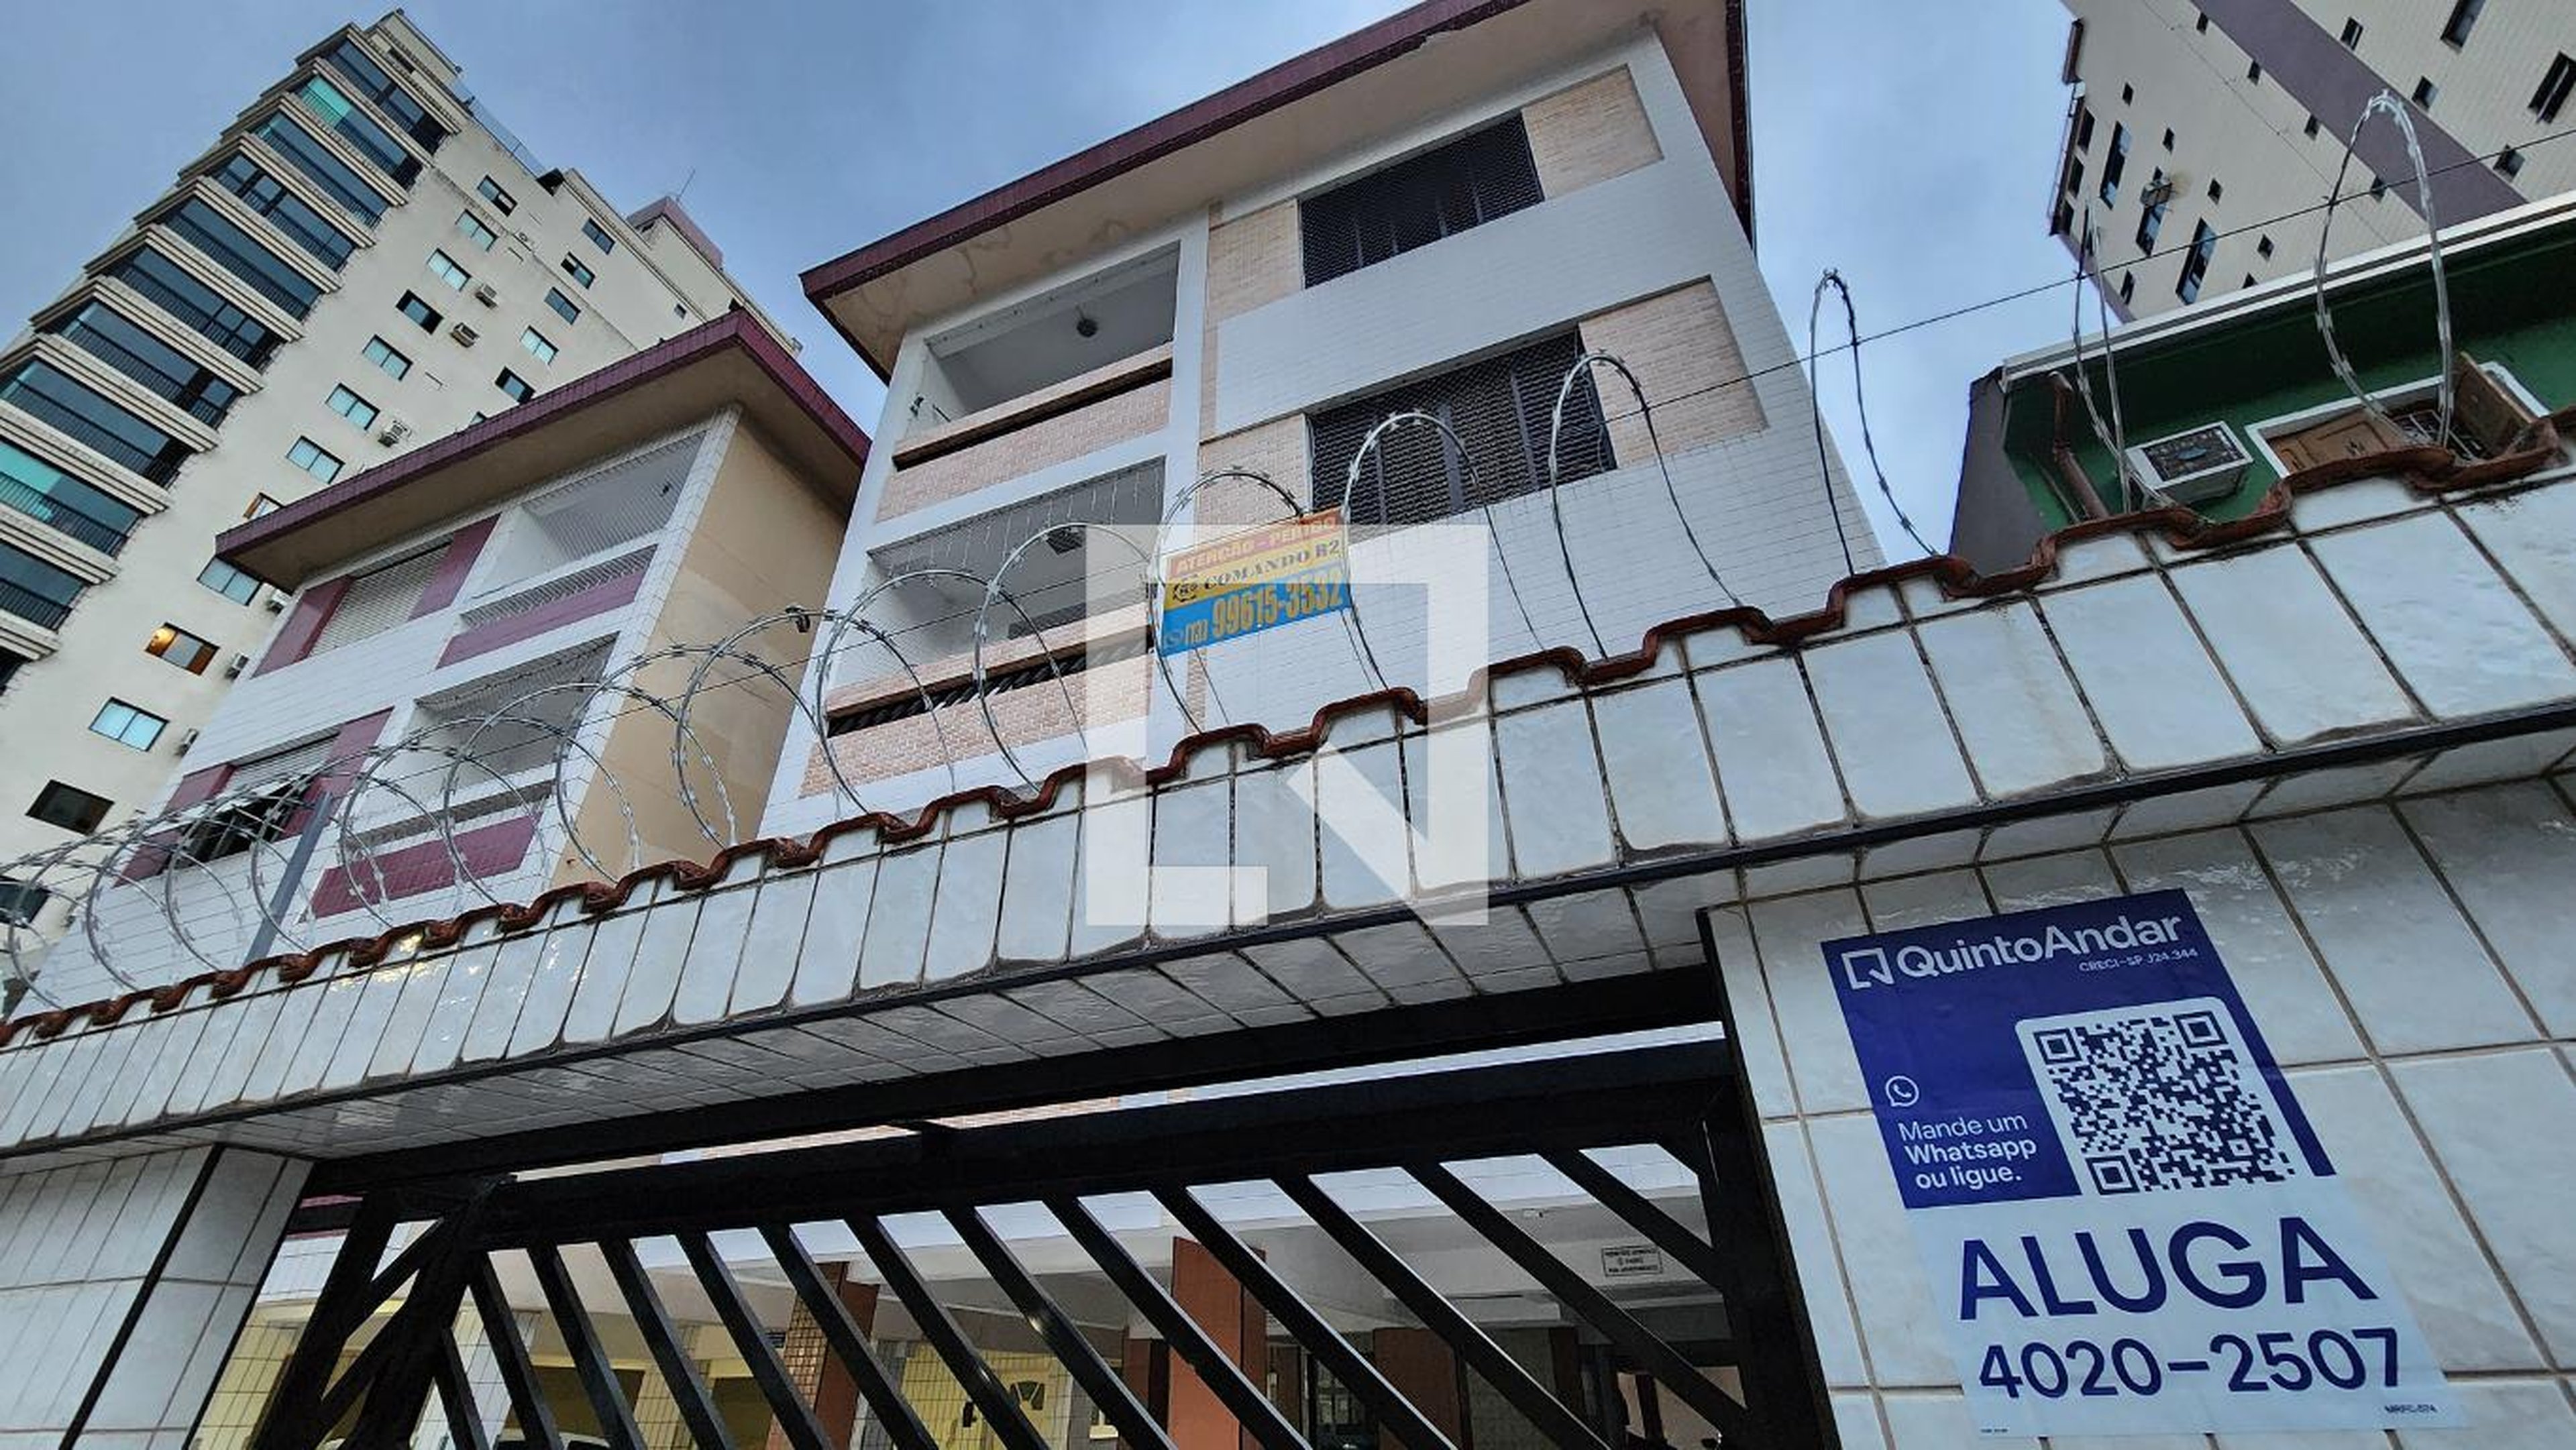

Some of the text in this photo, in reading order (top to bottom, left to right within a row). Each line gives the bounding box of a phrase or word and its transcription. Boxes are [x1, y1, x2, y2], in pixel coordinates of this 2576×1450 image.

[1205, 550, 1309, 590] COMANDO
[1316, 539, 1340, 558] R2
[1212, 571, 1342, 638] 99615-3532
[1896, 915, 2182, 977] QuintoAndar
[2079, 955, 2143, 971] CRECI-SP
[1898, 1115, 2028, 1141] Mande um
[1904, 1139, 2037, 1165] Whatsapp
[1915, 1166, 2022, 1190] ou ligue.
[1960, 1217, 2379, 1321] ALUGA
[1980, 1327, 2399, 1399] 4020-2507
